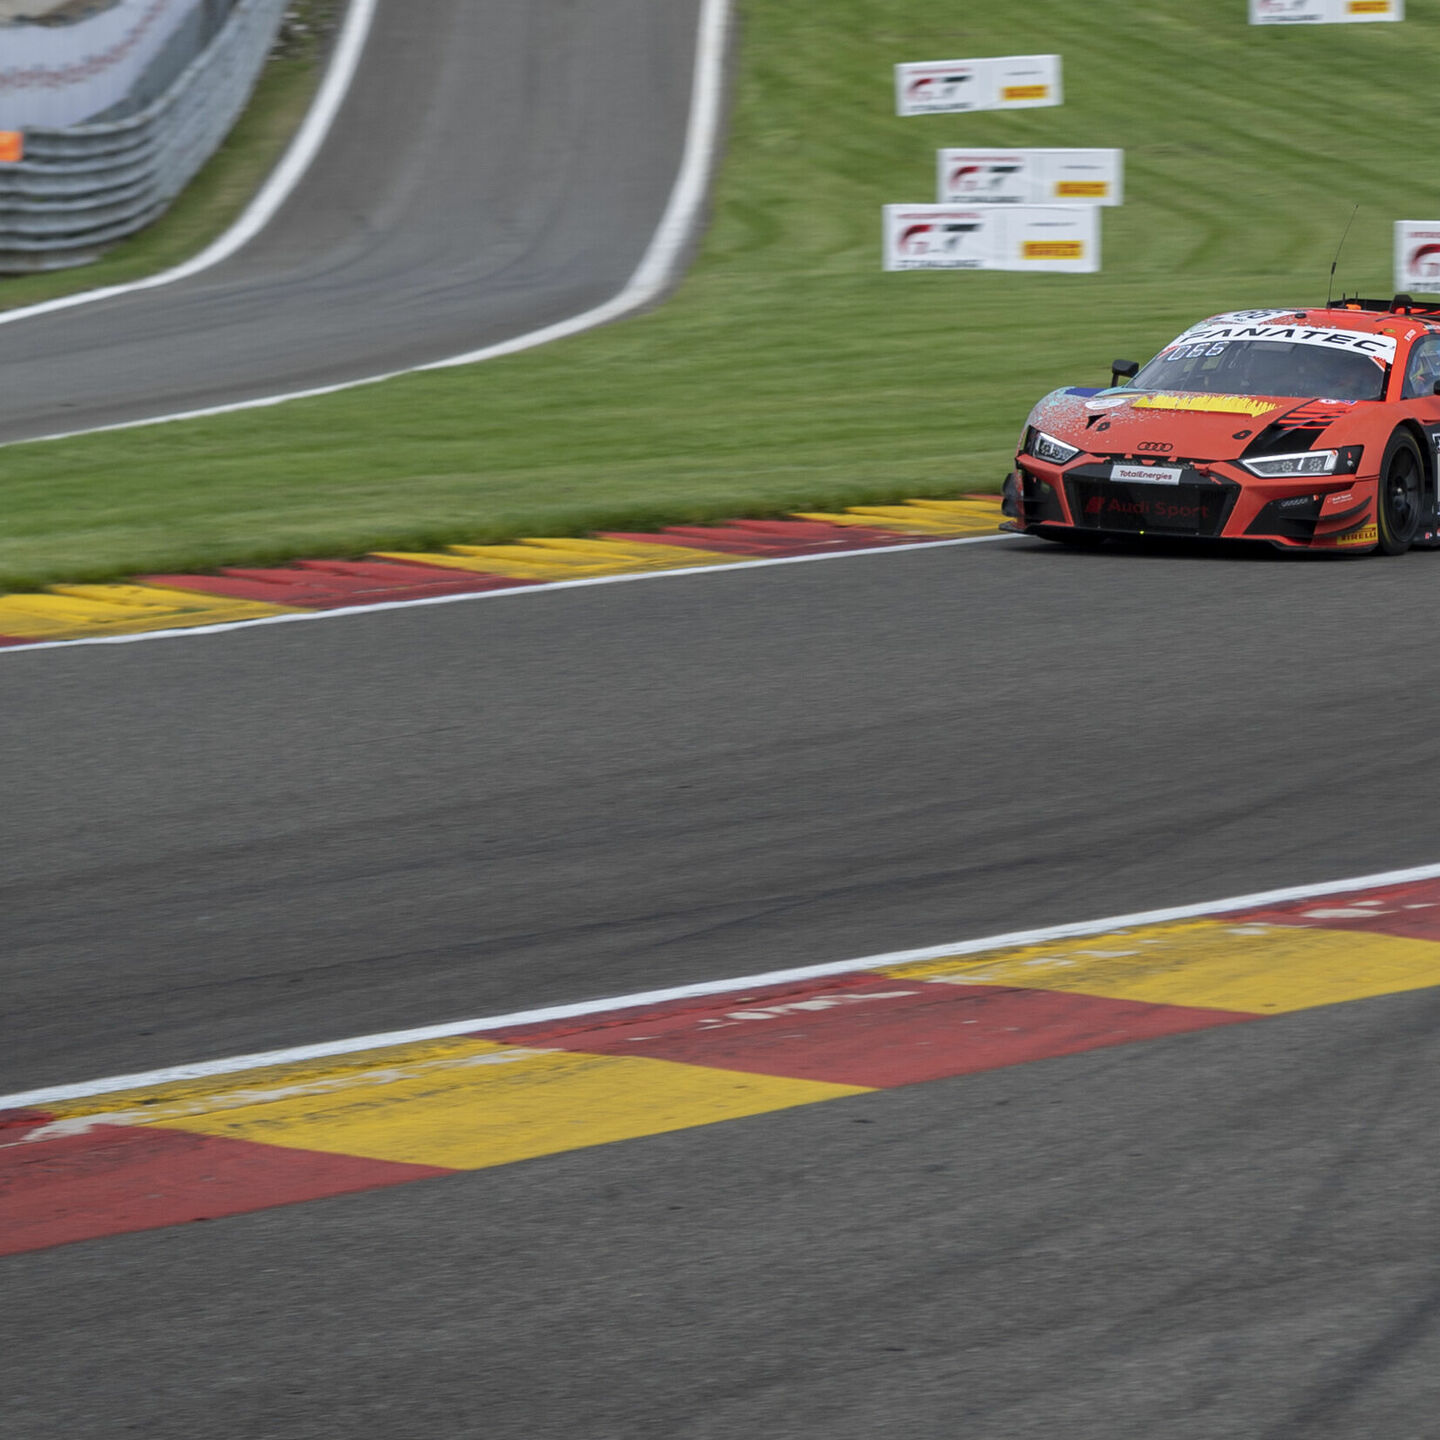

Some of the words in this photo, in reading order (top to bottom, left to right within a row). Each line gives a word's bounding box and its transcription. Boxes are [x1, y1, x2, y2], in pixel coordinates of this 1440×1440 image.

[1180, 327, 1388, 353] FANATEC
[1119, 470, 1173, 481] TotalEnergies
[1106, 498, 1150, 514] Audi
[1155, 503, 1209, 519] Sport
